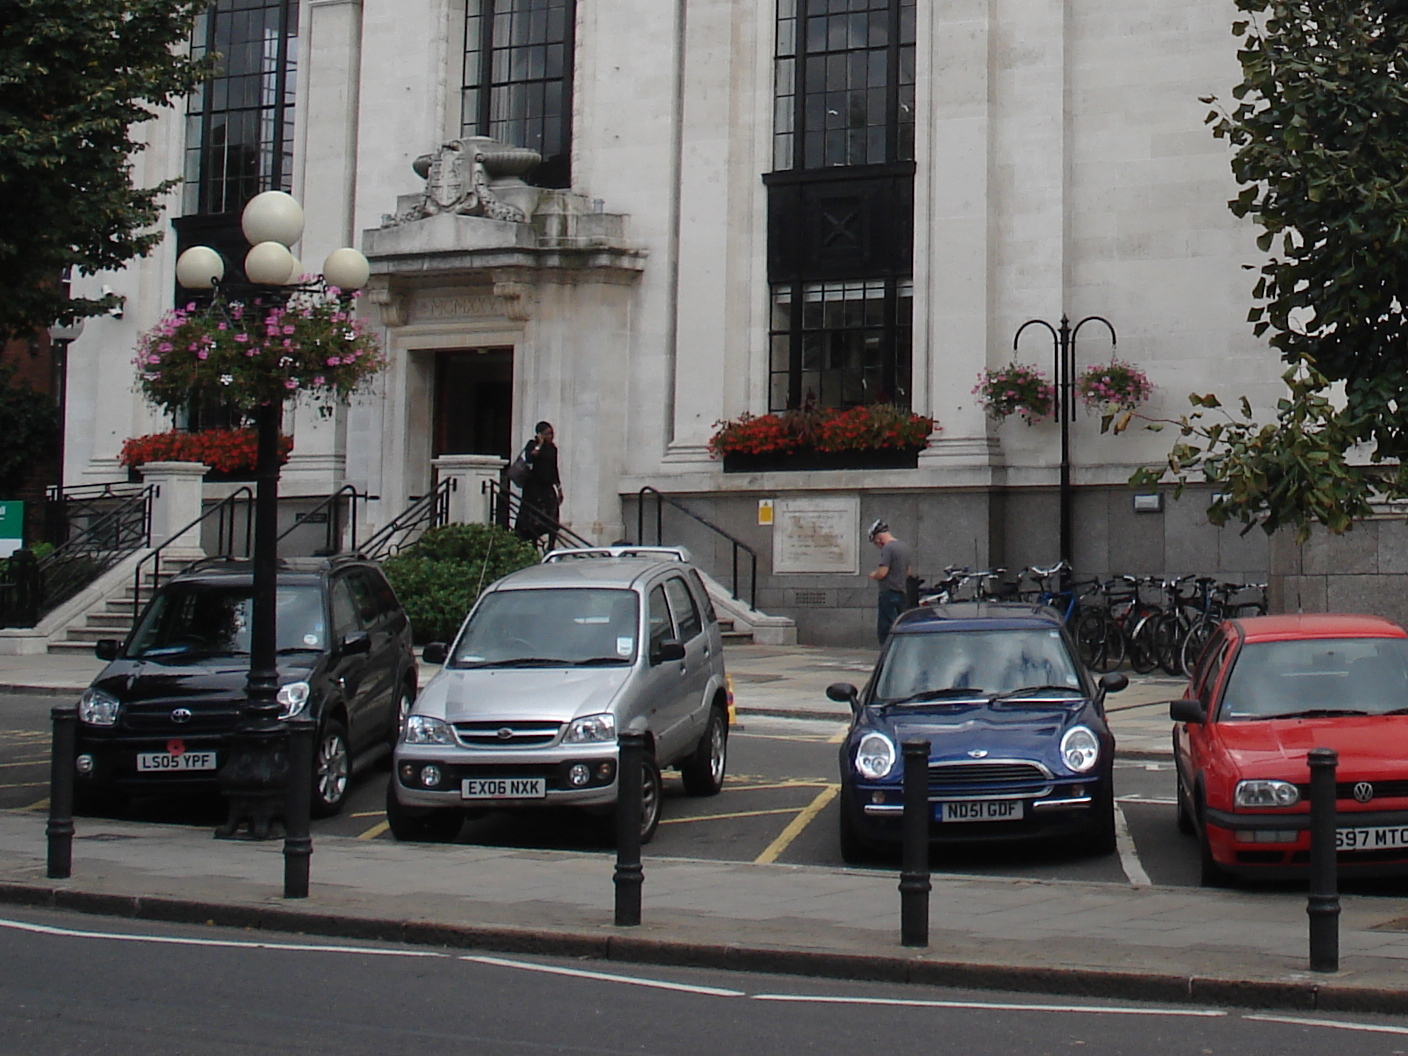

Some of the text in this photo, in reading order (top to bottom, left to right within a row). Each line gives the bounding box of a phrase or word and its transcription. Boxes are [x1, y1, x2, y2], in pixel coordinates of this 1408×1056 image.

[142, 754, 210, 769] LS05 YPF
[468, 780, 539, 795] EX06 NXK
[948, 802, 1016, 819] ND51 GDF
